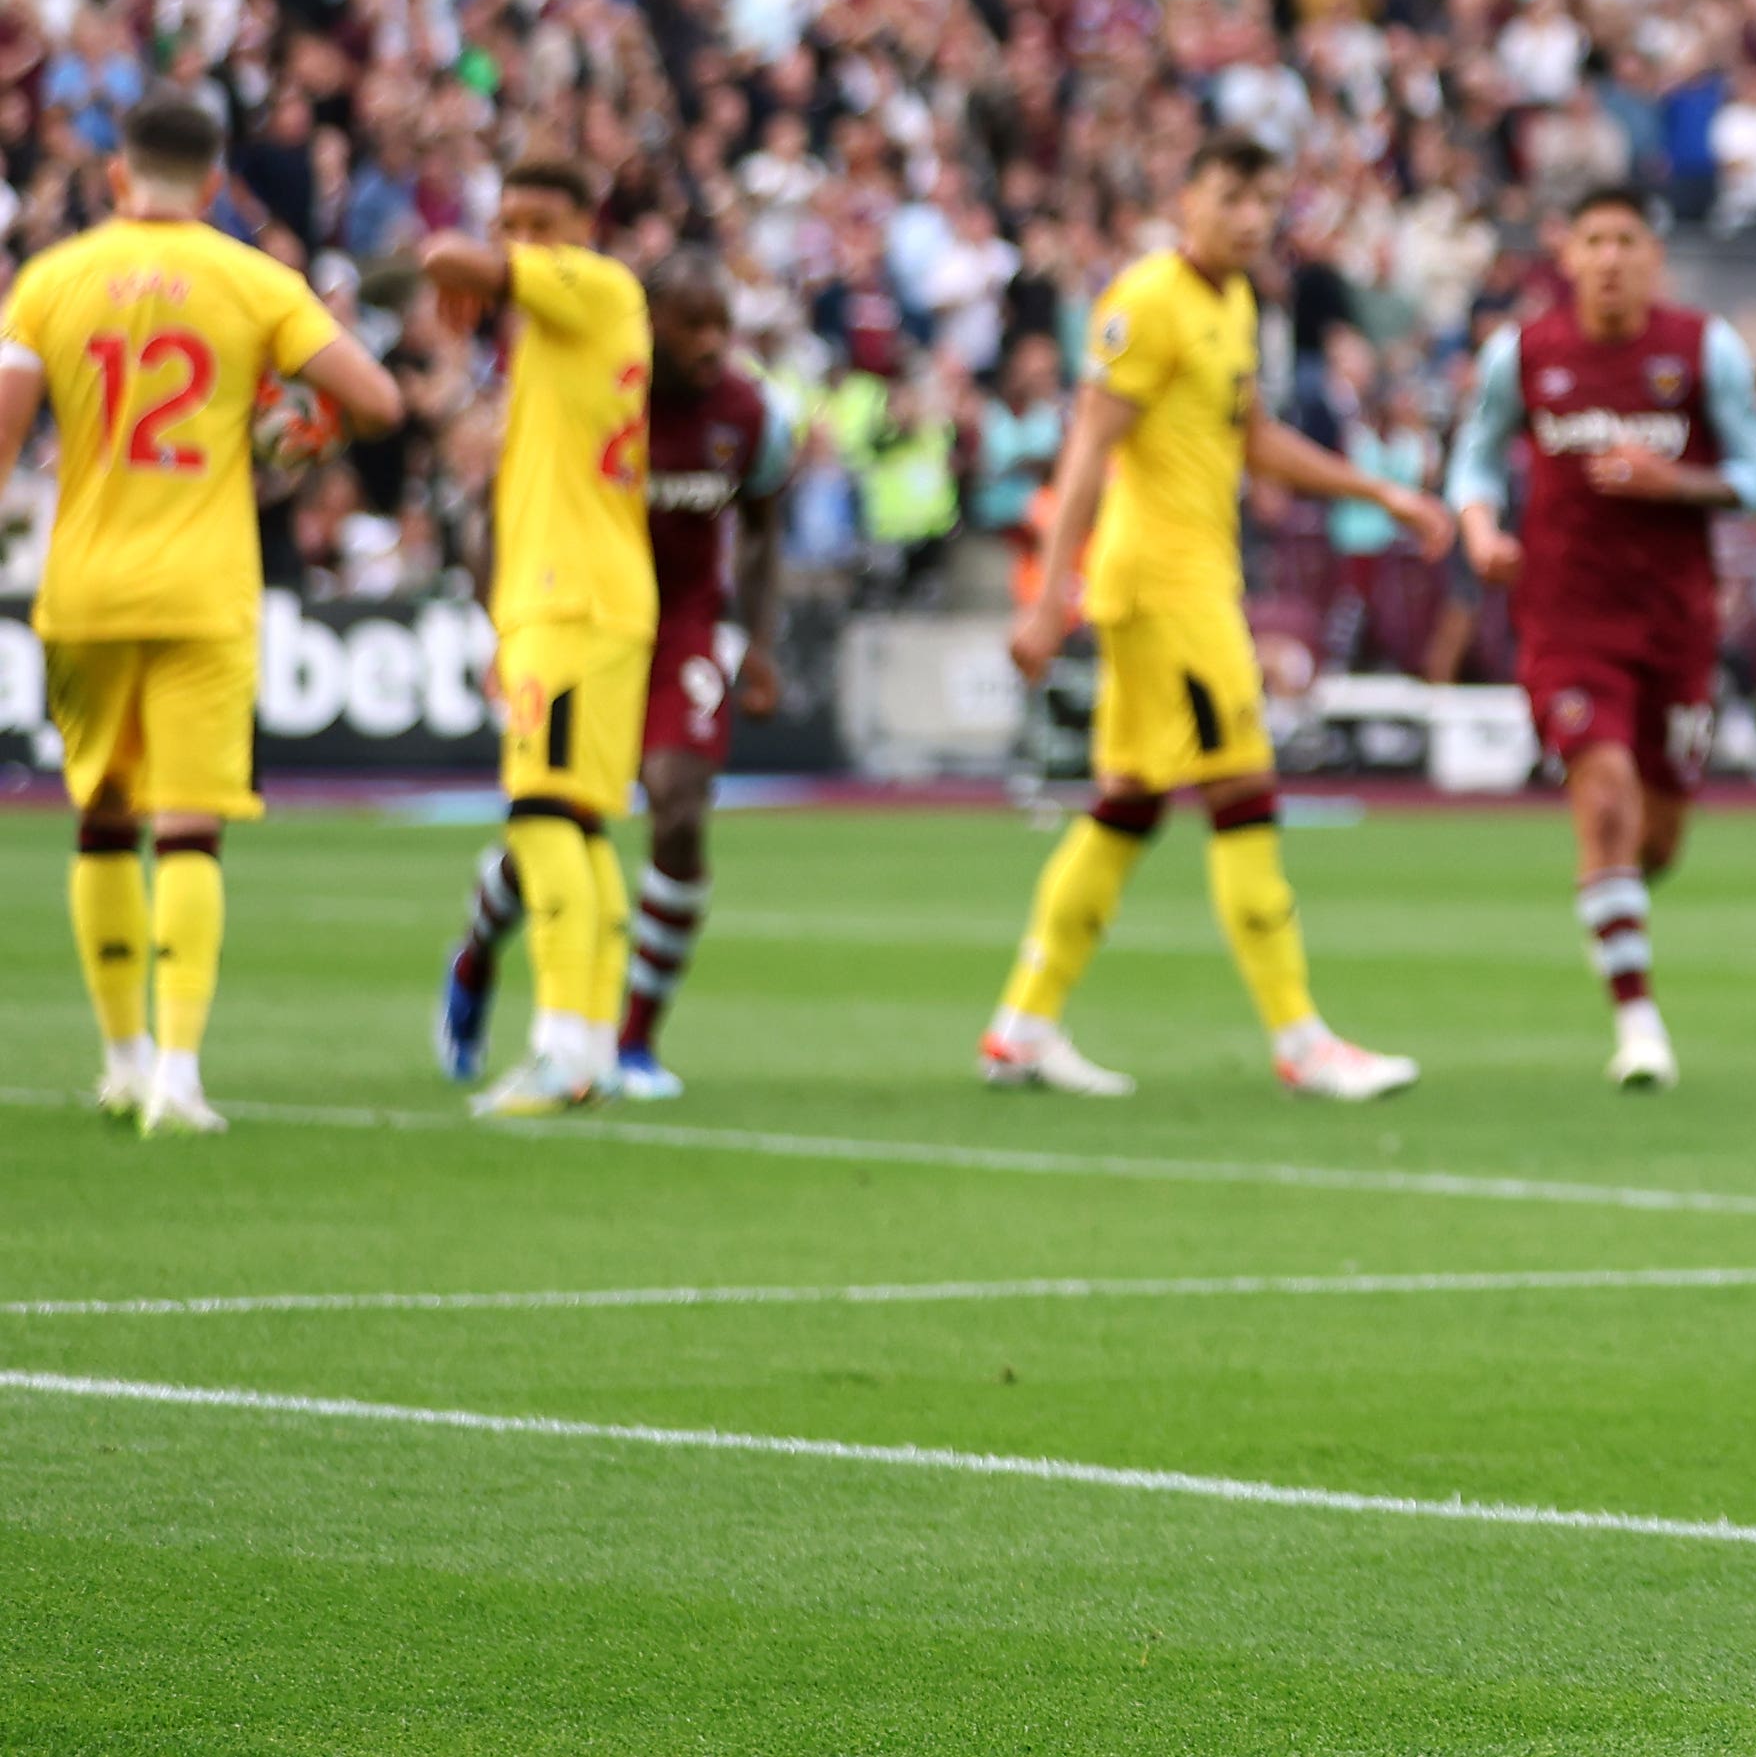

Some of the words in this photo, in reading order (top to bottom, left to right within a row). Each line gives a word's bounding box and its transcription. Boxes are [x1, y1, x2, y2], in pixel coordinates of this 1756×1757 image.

[84, 327, 217, 474] 12
[258, 587, 500, 740] bet
[680, 652, 728, 722] 9
